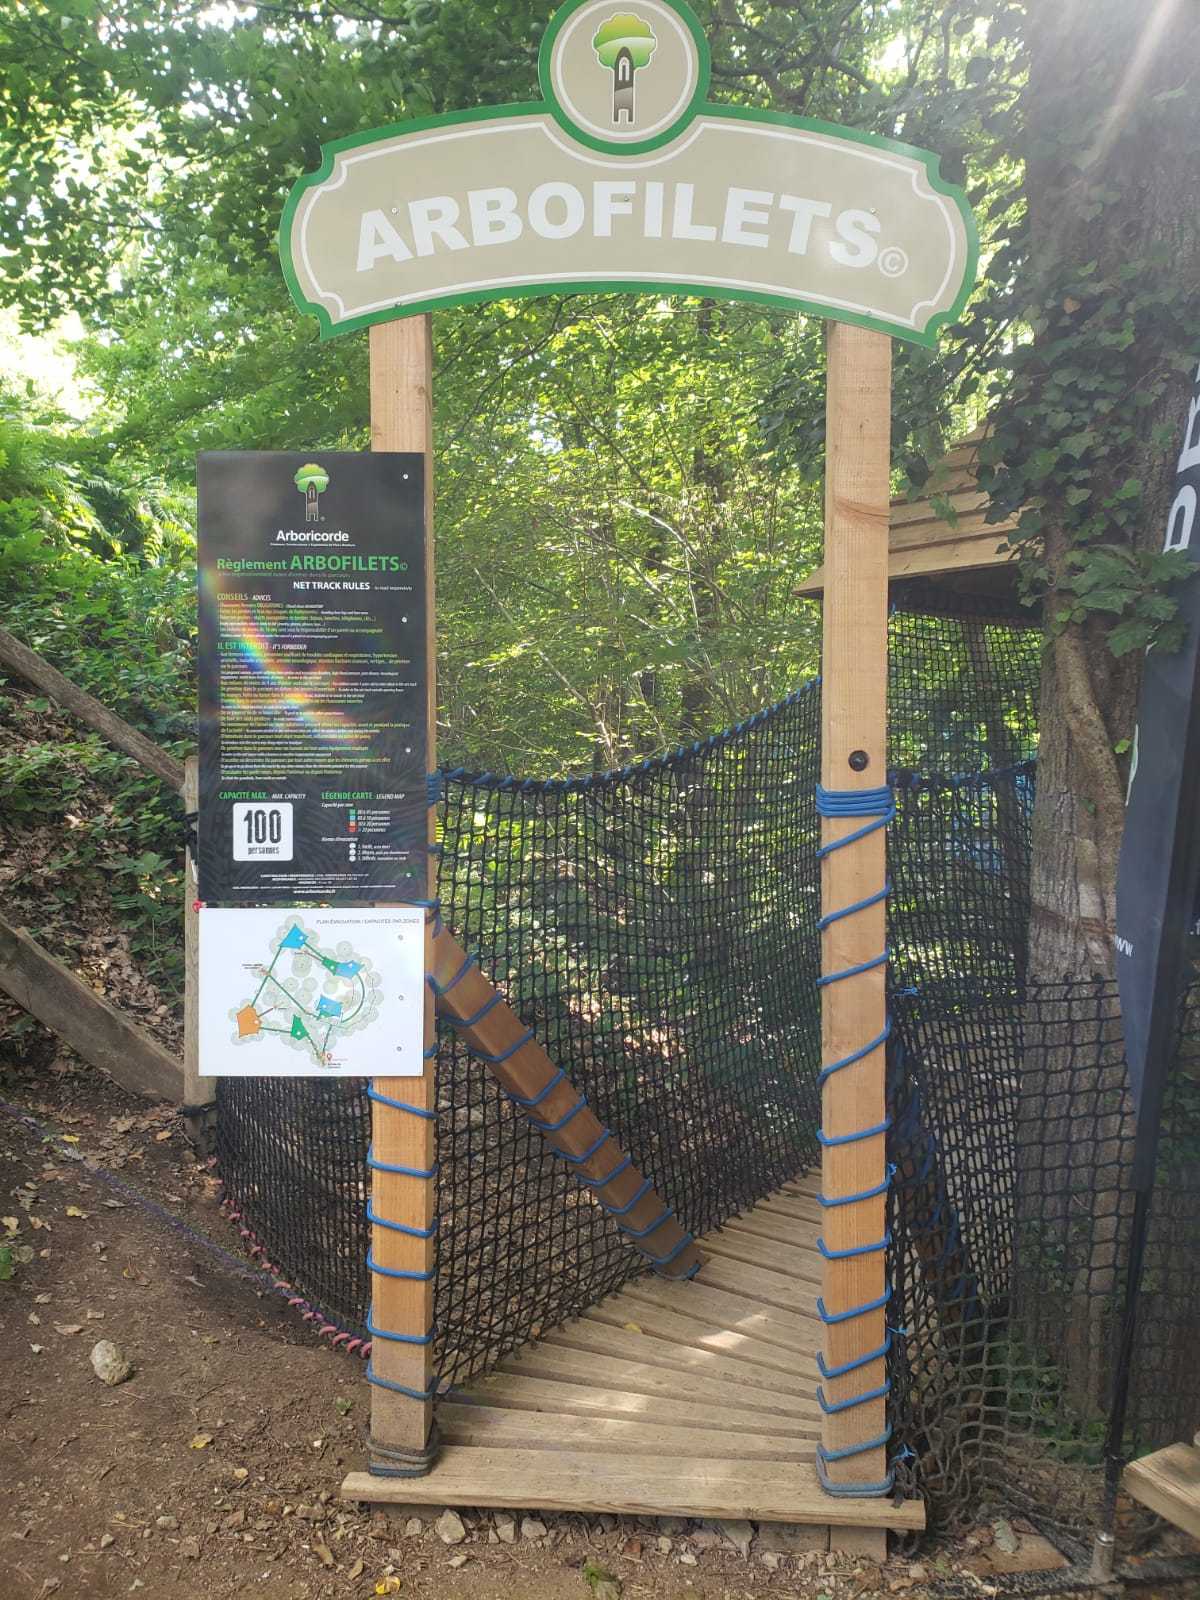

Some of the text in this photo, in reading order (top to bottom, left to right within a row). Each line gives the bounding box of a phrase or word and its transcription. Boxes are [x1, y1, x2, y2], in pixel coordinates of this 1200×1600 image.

[276, 529, 350, 542] Arboricorde
[216, 558, 288, 573] Règlement
[293, 581, 370, 591] NET TRACK RULES
[217, 593, 249, 602] CONSEILS
[243, 809, 281, 844] 100
[247, 846, 280, 855] personnes
